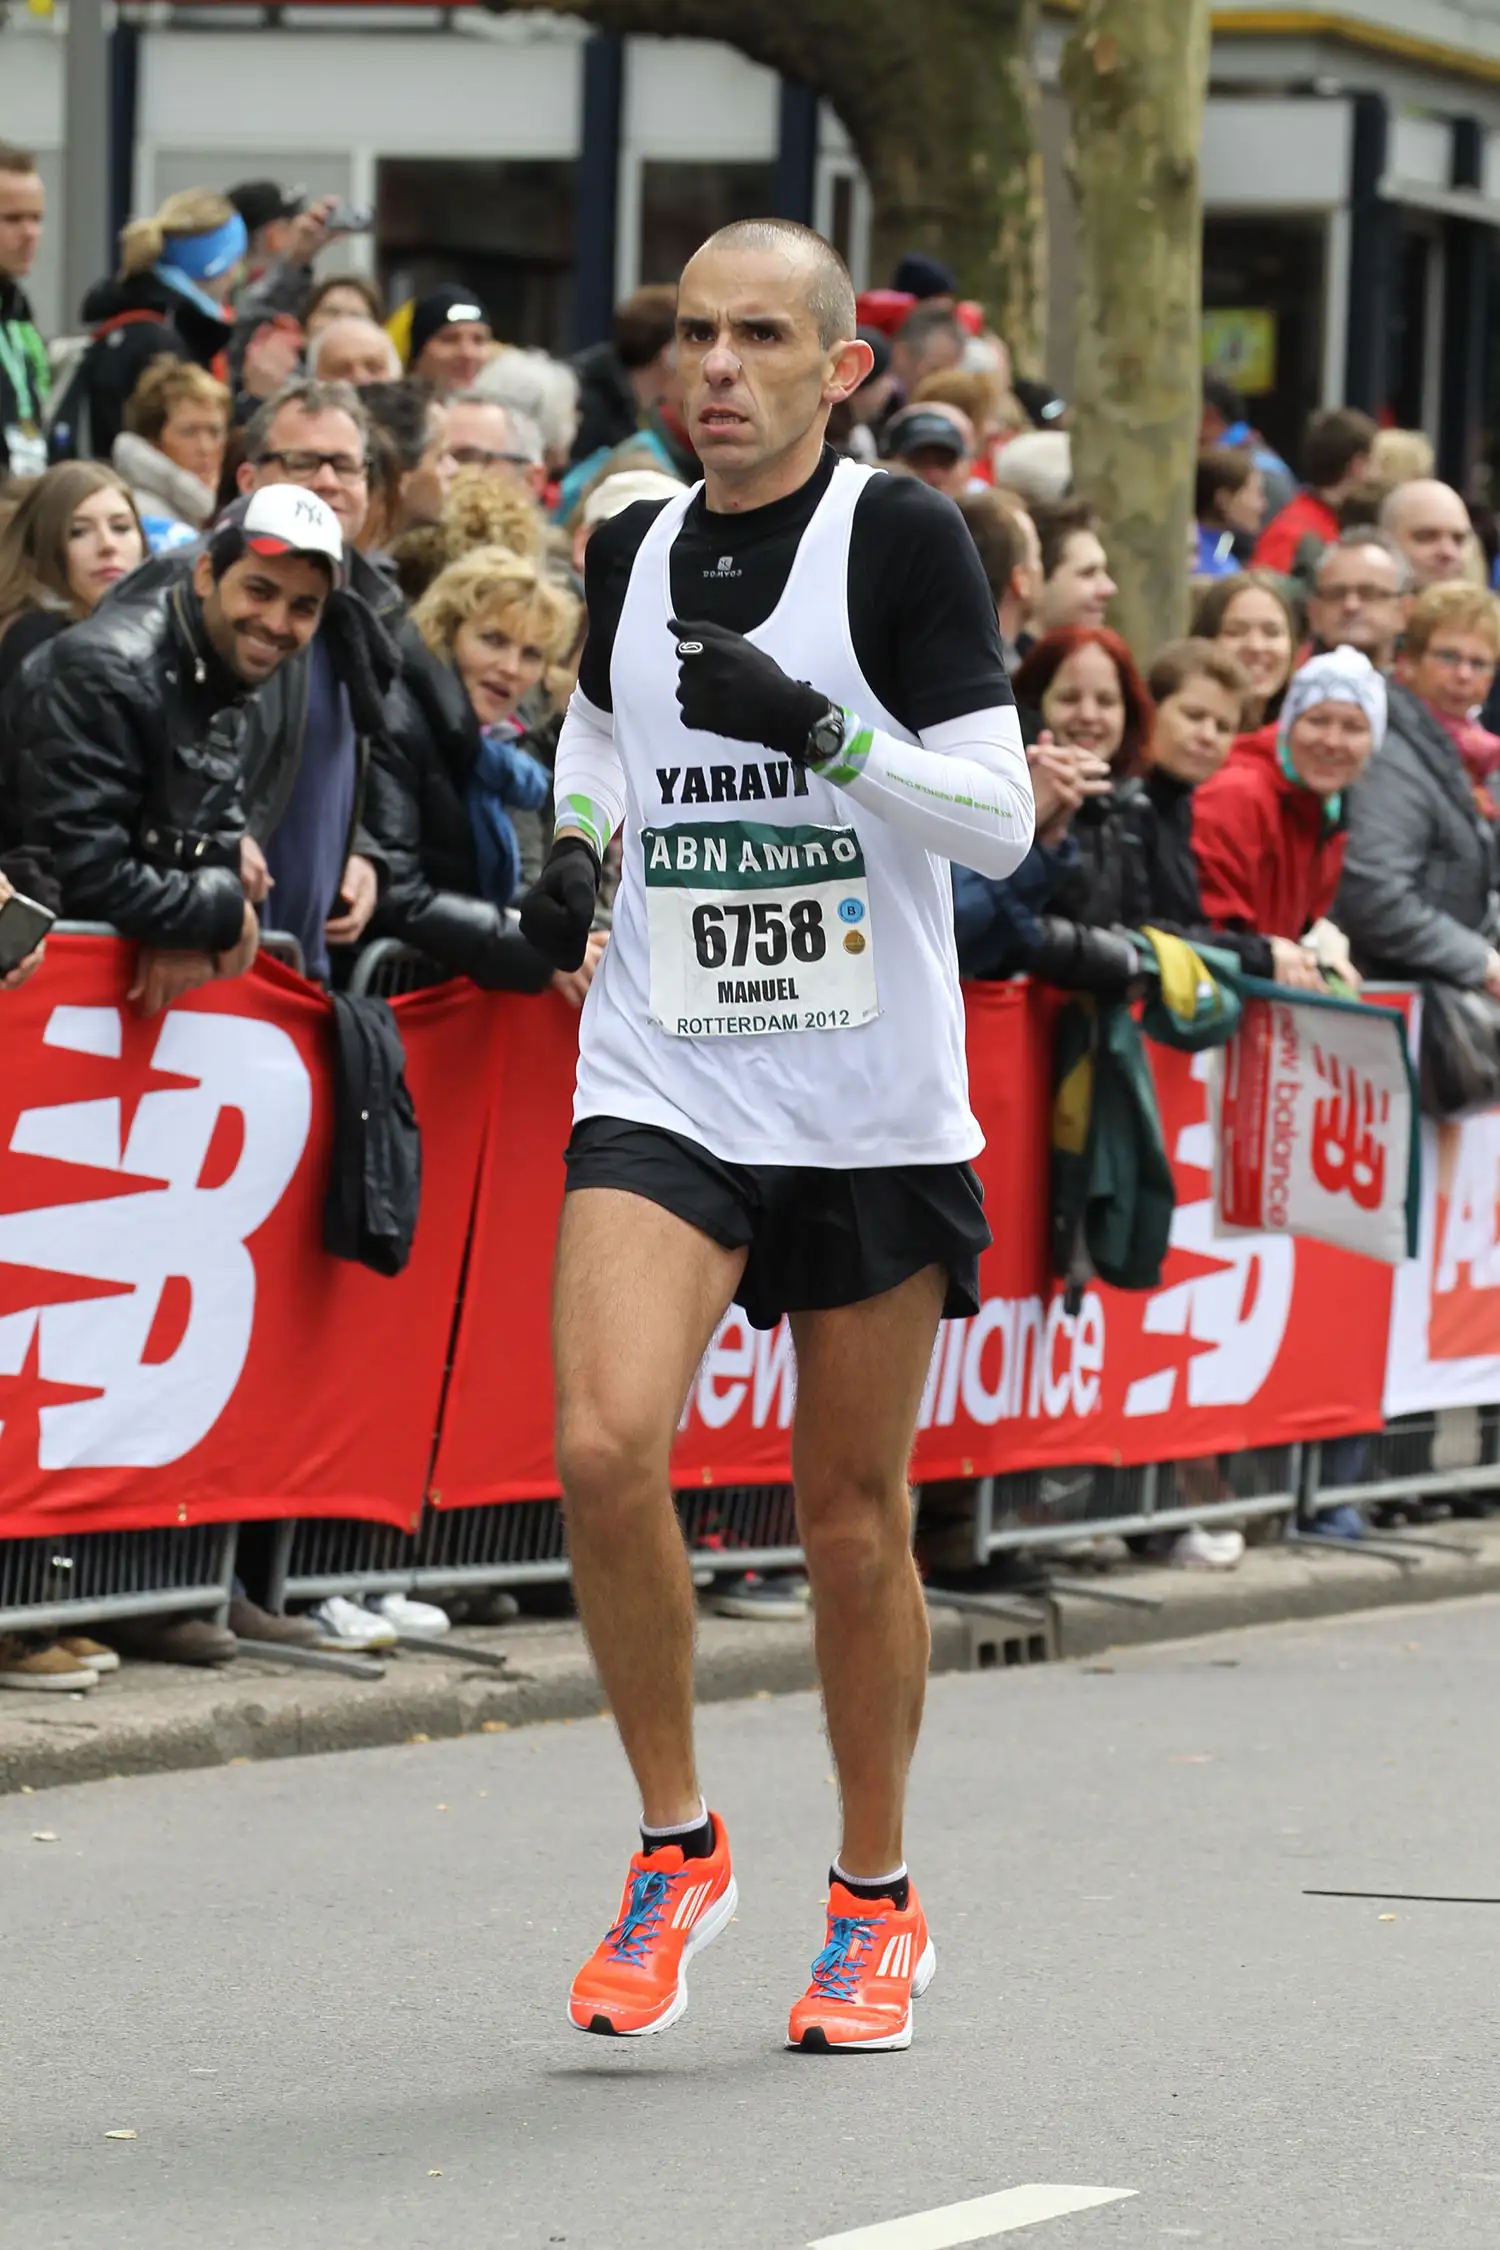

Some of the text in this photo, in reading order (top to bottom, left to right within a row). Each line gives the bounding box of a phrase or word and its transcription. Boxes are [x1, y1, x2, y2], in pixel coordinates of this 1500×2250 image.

[656, 761, 809, 804] YARAVI
[650, 836, 857, 873] ABN AMRO
[692, 899, 827, 969] 6758
[717, 977, 799, 1004] MANUEL
[677, 1009, 850, 1034] ROTTERDAM 2012
[676, 1302, 798, 1432] ew
[916, 1292, 1105, 1430] lance
